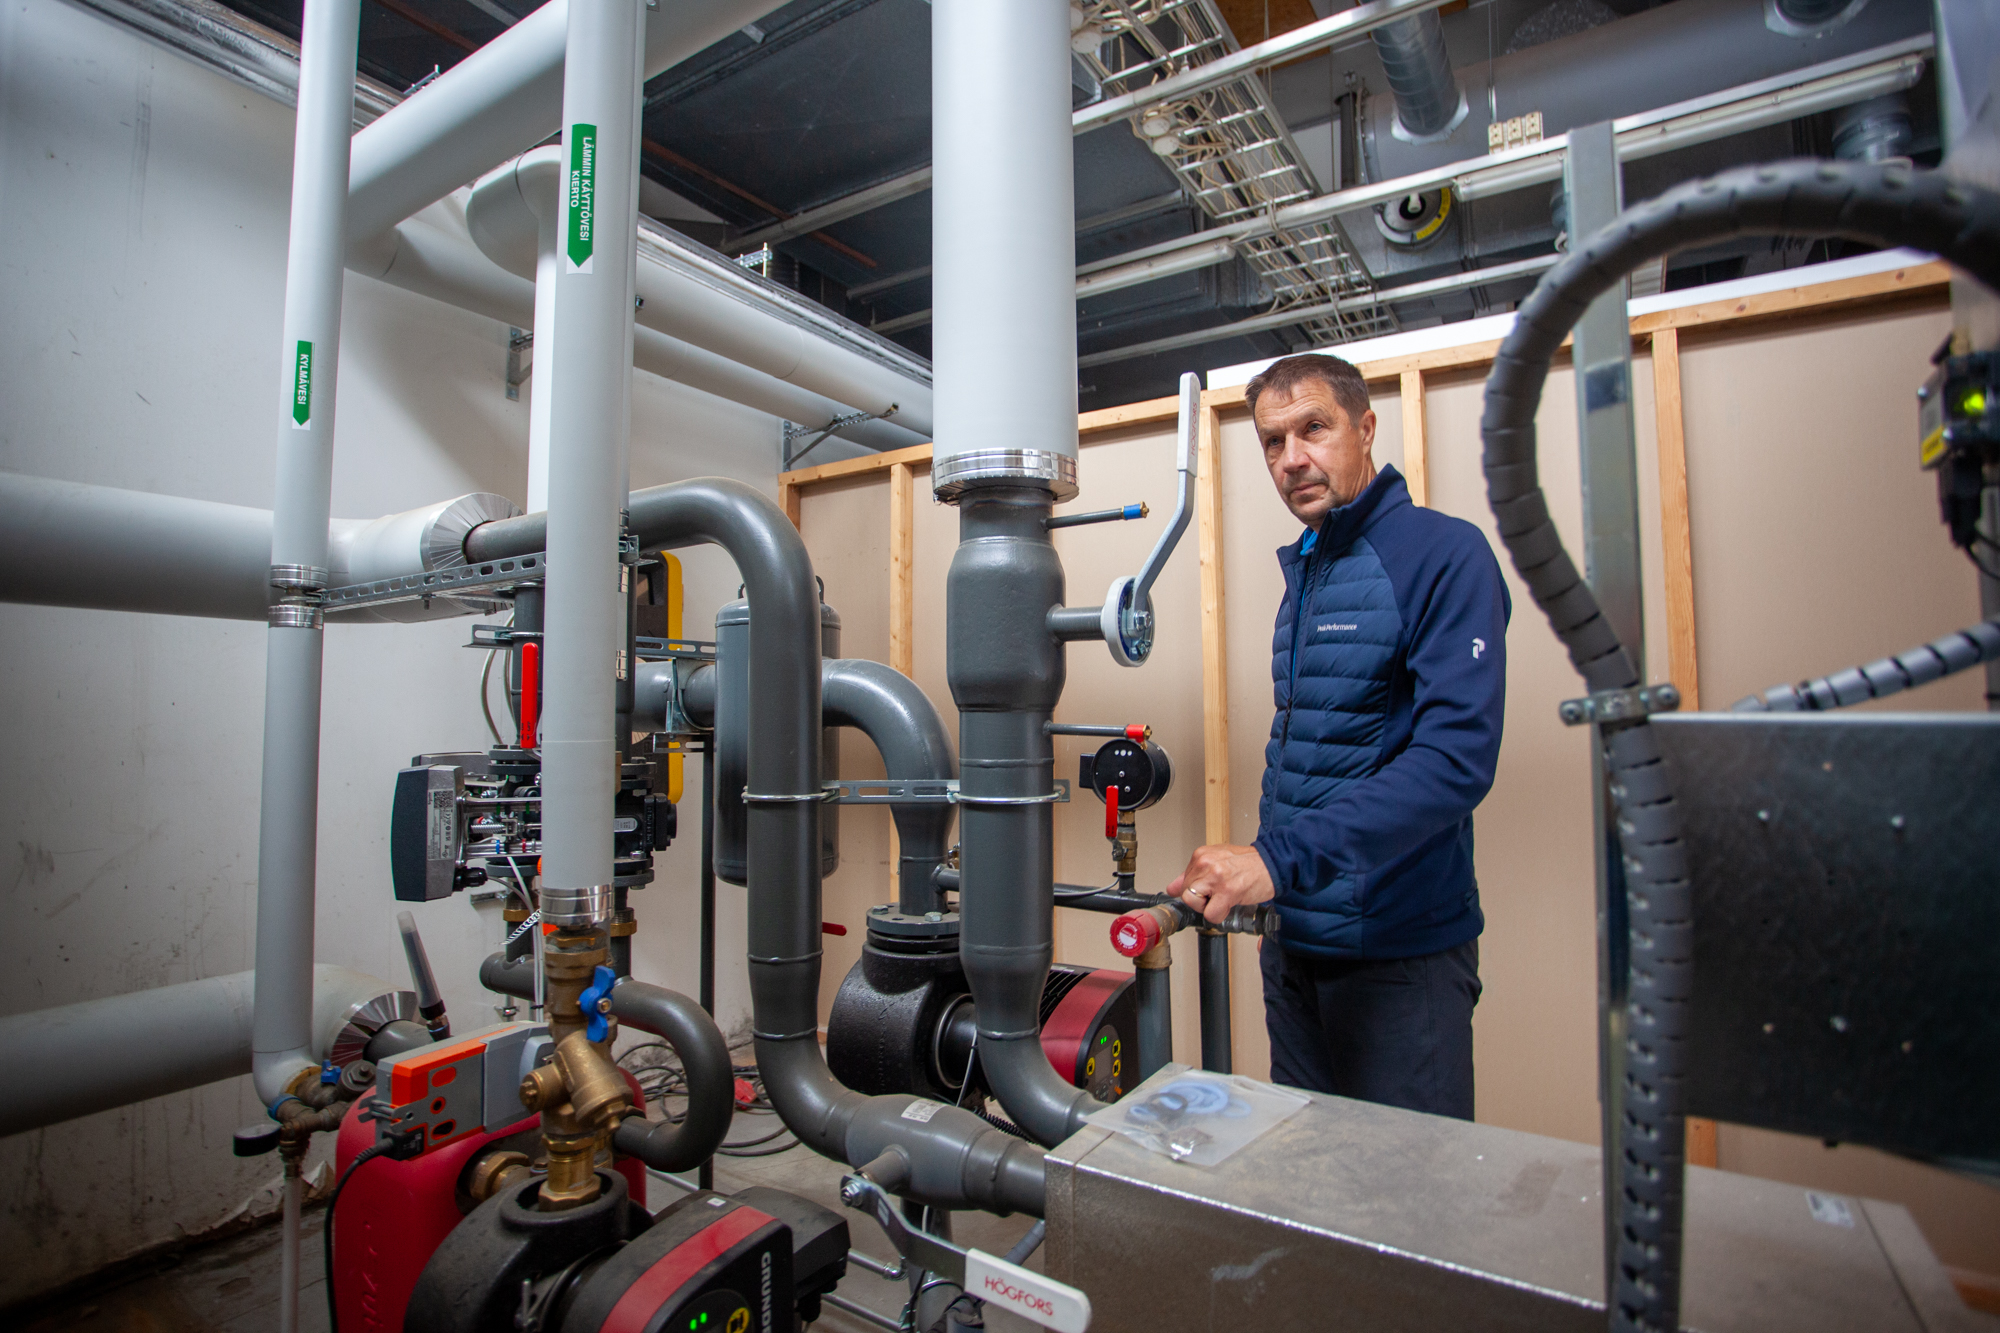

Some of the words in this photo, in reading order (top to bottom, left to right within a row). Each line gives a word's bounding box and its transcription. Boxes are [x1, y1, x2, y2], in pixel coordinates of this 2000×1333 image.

[582, 137, 594, 177] LÄMMIN
[570, 170, 580, 208] KIERTO
[580, 179, 593, 241] KÄYTTÖVESI
[297, 353, 309, 405] KYLMÄVESI
[985, 1275, 1053, 1316] HÖGFORS
